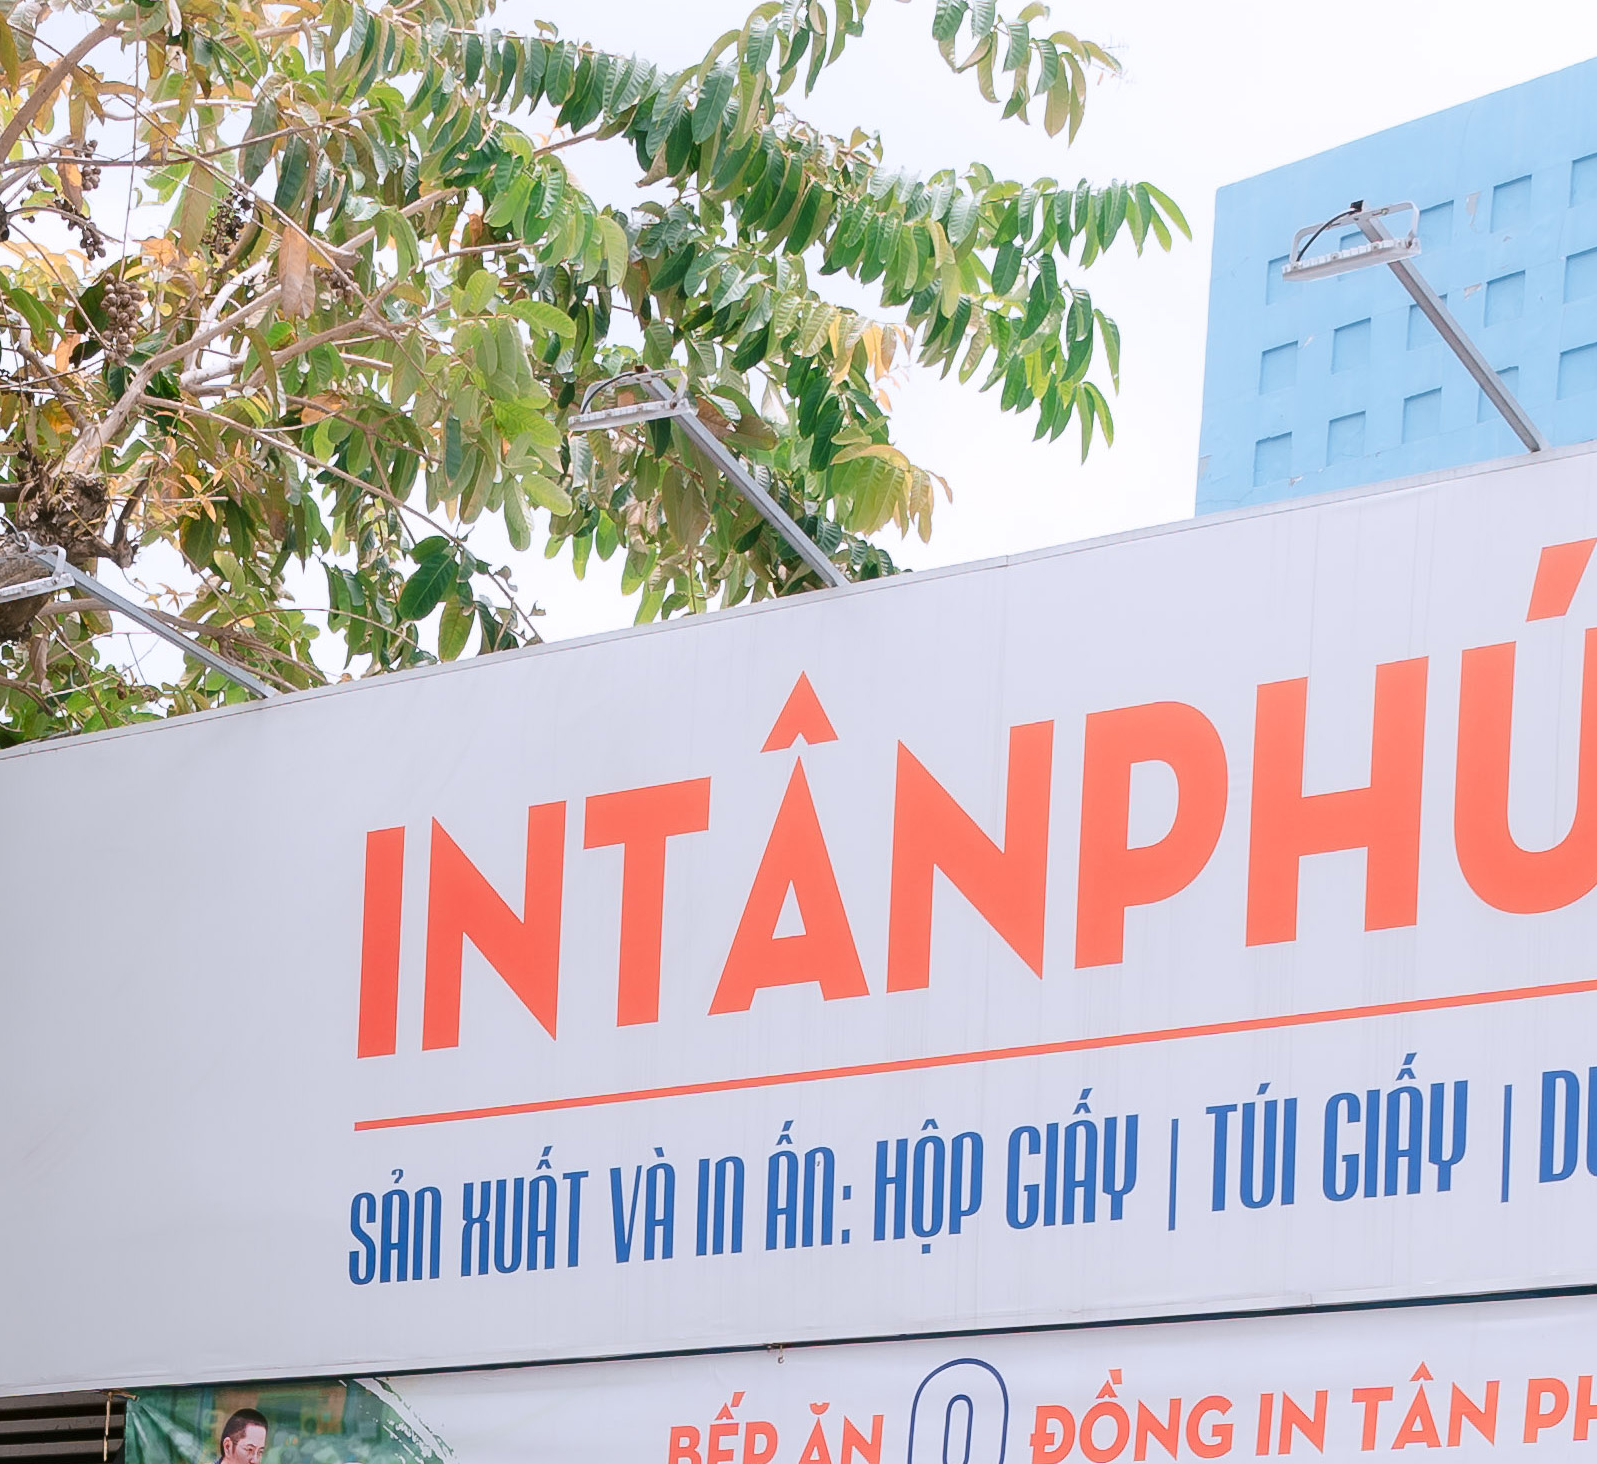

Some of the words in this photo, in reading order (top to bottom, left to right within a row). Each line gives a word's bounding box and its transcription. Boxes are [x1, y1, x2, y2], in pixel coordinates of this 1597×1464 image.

[349, 1170, 441, 1284] SẢN
[461, 1146, 588, 1276] XUẤT
[610, 1147, 675, 1263] VÀ
[697, 1157, 744, 1255] IN
[766, 1121, 851, 1250] ẤN:
[874, 1119, 983, 1253] HỘP
[1007, 1088, 1138, 1229] GIẤY
[1206, 1087, 1297, 1211] TÚI
[1323, 1053, 1467, 1201] GIẤY
[1030, 1370, 1233, 1464] ĐỒNG
[1257, 1391, 1327, 1455] IN
[1353, 1363, 1499, 1450] TÂN
